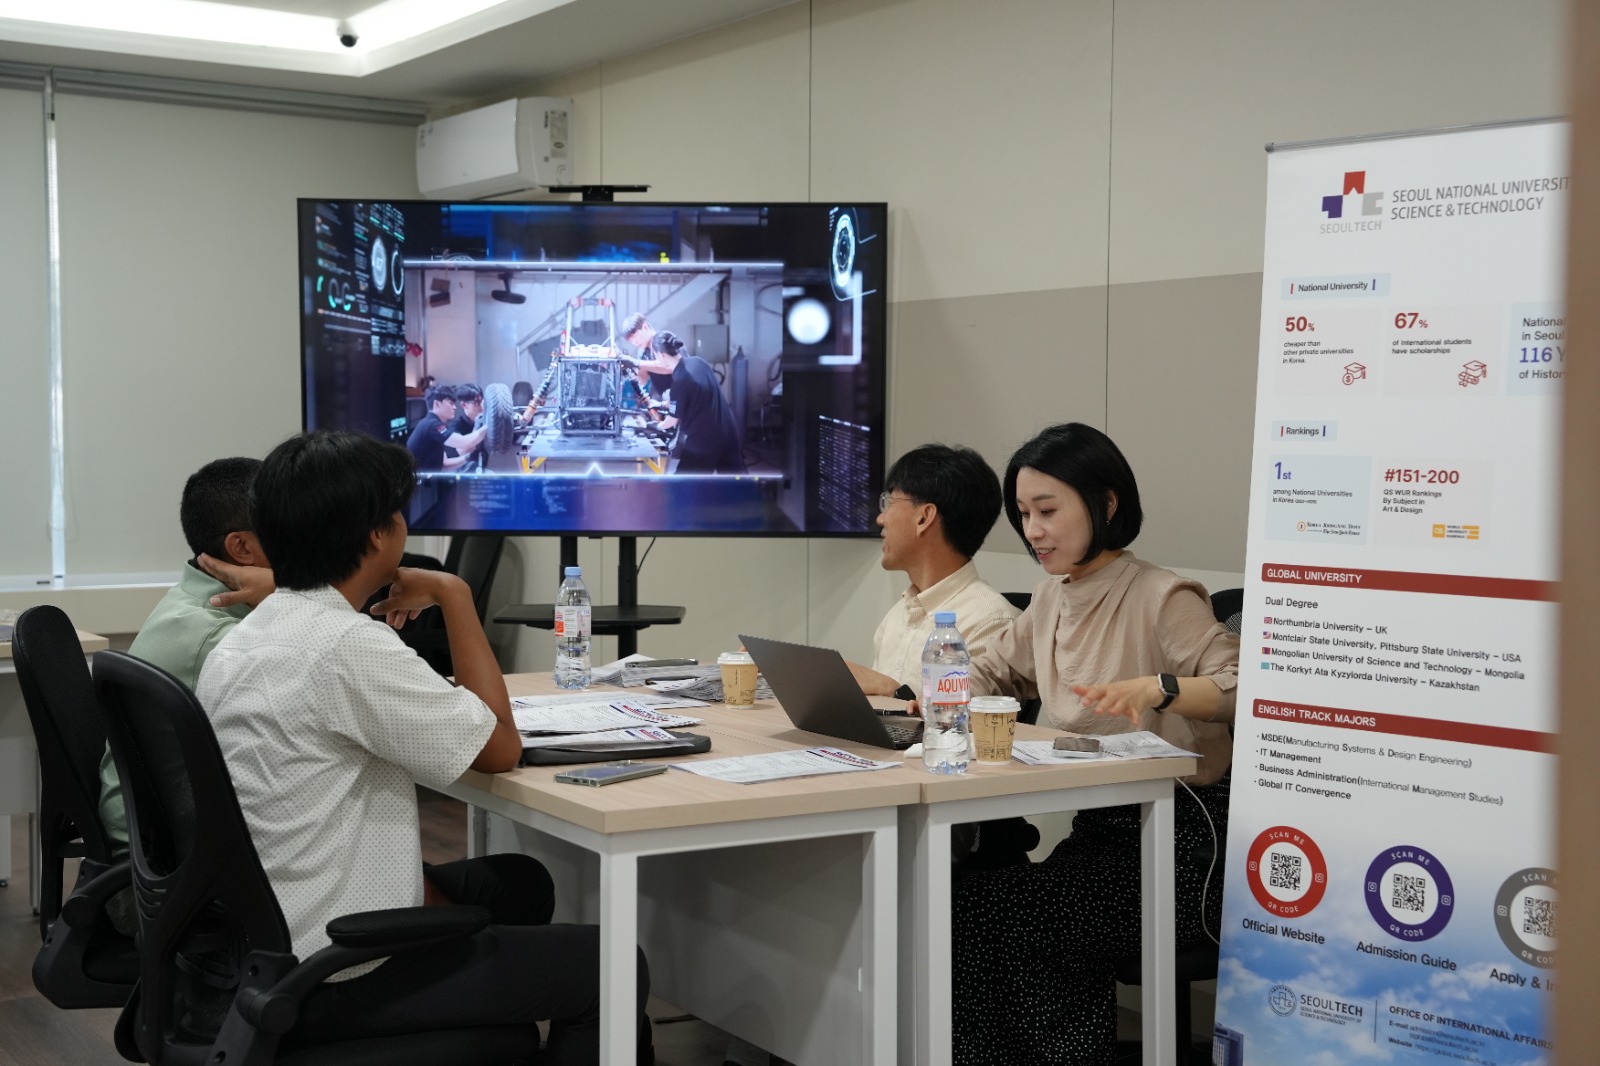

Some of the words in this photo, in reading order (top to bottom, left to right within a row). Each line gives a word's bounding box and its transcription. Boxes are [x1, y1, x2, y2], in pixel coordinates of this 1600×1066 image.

[1392, 188, 1432, 203] SEOUL
[1436, 182, 1498, 200] NATIONAL
[1502, 176, 1570, 194] UNIVERSIT
[1390, 204, 1442, 220] SCIENCE
[1445, 204, 1454, 216] &
[1456, 196, 1544, 216] TECHNOLOGY
[1320, 220, 1382, 234] SEOULTECH
[1298, 283, 1328, 292] National
[1330, 282, 1368, 290] University
[1285, 316, 1315, 332] 50%
[1394, 312, 1428, 330] 67%
[1522, 332, 1531, 340] in
[1519, 346, 1553, 363] 116
[1518, 370, 1529, 379] of
[1532, 369, 1564, 379] Histor
[1286, 426, 1320, 436] Rankings
[1274, 461, 1292, 480] 1st
[1384, 468, 1460, 484] #151-200
[1317, 490, 1353, 498] Universities
[1412, 490, 1442, 498] Rankings
[1266, 568, 1302, 580] GLOBAL
[1304, 571, 1363, 583] UNIVERSITY
[1265, 596, 1284, 606] Dual
[1286, 598, 1319, 609] Degree
[1273, 617, 1320, 629] Northumbria
[1322, 621, 1364, 633] University
[1375, 626, 1388, 635] UK
[1272, 632, 1307, 643] Montclair
[1309, 636, 1330, 645] State
[1380, 642, 1419, 654] Pittsburg
[1421, 645, 1444, 656] State
[1446, 648, 1490, 660] University
[1502, 653, 1522, 663] USA
[1271, 647, 1310, 659] Mongolian
[1312, 651, 1353, 664] University
[1366, 656, 1401, 668] Science
[1403, 661, 1420, 670] and
[1423, 662, 1473, 676] Technology
[1484, 668, 1525, 680] Mongolia
[938, 676, 970, 694] AQUVIV
[1270, 663, 1284, 672] The
[1286, 664, 1312, 675] Korkyt
[1314, 667, 1329, 676] Ata
[1375, 673, 1418, 686] University
[1429, 678, 1480, 692] Kazakhstan
[1258, 704, 1296, 718] ENGLISH
[1298, 709, 1332, 722] TRACK
[1334, 713, 1376, 727] MAJORS
[1260, 748, 1268, 756] IT
[1269, 749, 1322, 764] Management
[1261, 732, 1340, 751] MSDE(Manufacturing
[1342, 743, 1376, 755] Systems
[1378, 748, 1385, 756] &
[1388, 748, 1417, 761] Design
[1419, 752, 1472, 768] Engineering)
[1258, 778, 1283, 790] Global
[1285, 782, 1293, 791] IT
[1295, 784, 1352, 800] Convergence
[1259, 763, 1294, 776] Business
[1412, 784, 1466, 800] Management
[1468, 792, 1504, 806] Studies)
[1269, 832, 1290, 840] SCAN
[1293, 835, 1305, 845] ME
[1391, 851, 1414, 860] SCAN
[1418, 855, 1431, 866] ME
[1522, 873, 1547, 883] SCAN
[1267, 901, 1277, 910] QR
[1279, 906, 1300, 914] CODE
[1242, 918, 1278, 935] Official
[1281, 925, 1325, 944] Website
[1390, 924, 1400, 934] QR
[1403, 928, 1424, 937] CODE
[1356, 941, 1417, 963] Admission
[1421, 953, 1457, 971] Guide
[1521, 950, 1533, 960] QR
[1536, 956, 1554, 964] COD
[1490, 968, 1527, 987] Apply
[1531, 976, 1541, 989] &
[1300, 994, 1363, 1017] SEOULTECH
[1389, 1005, 1421, 1020] OFFICE
[1423, 1012, 1435, 1023] OF
[1436, 1016, 1510, 1041] INTERNATIONAL
